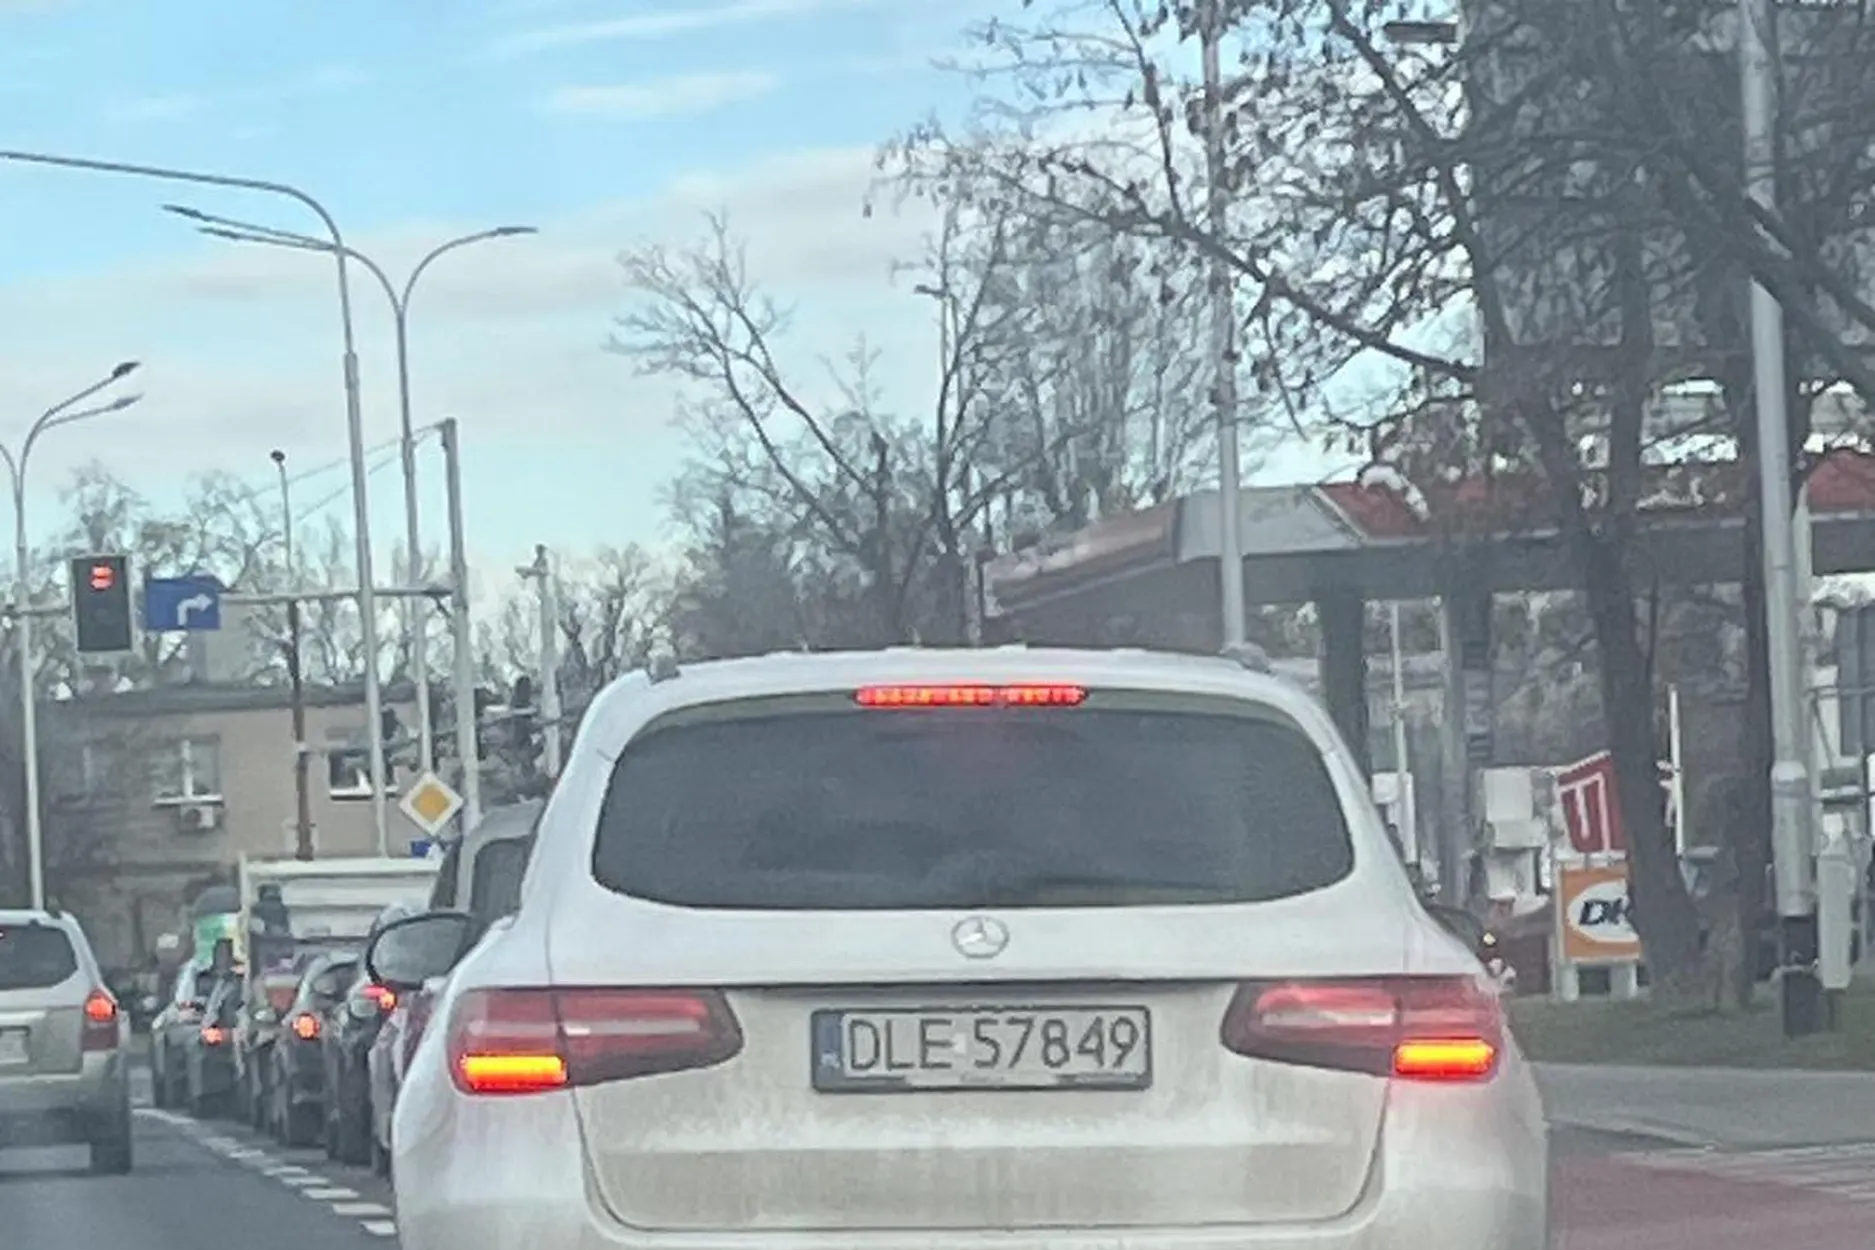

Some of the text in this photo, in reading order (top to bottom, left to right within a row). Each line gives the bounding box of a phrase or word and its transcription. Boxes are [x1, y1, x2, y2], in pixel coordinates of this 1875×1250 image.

[1579, 898, 1629, 926] DK
[850, 1016, 1139, 1071] DLE 57849
